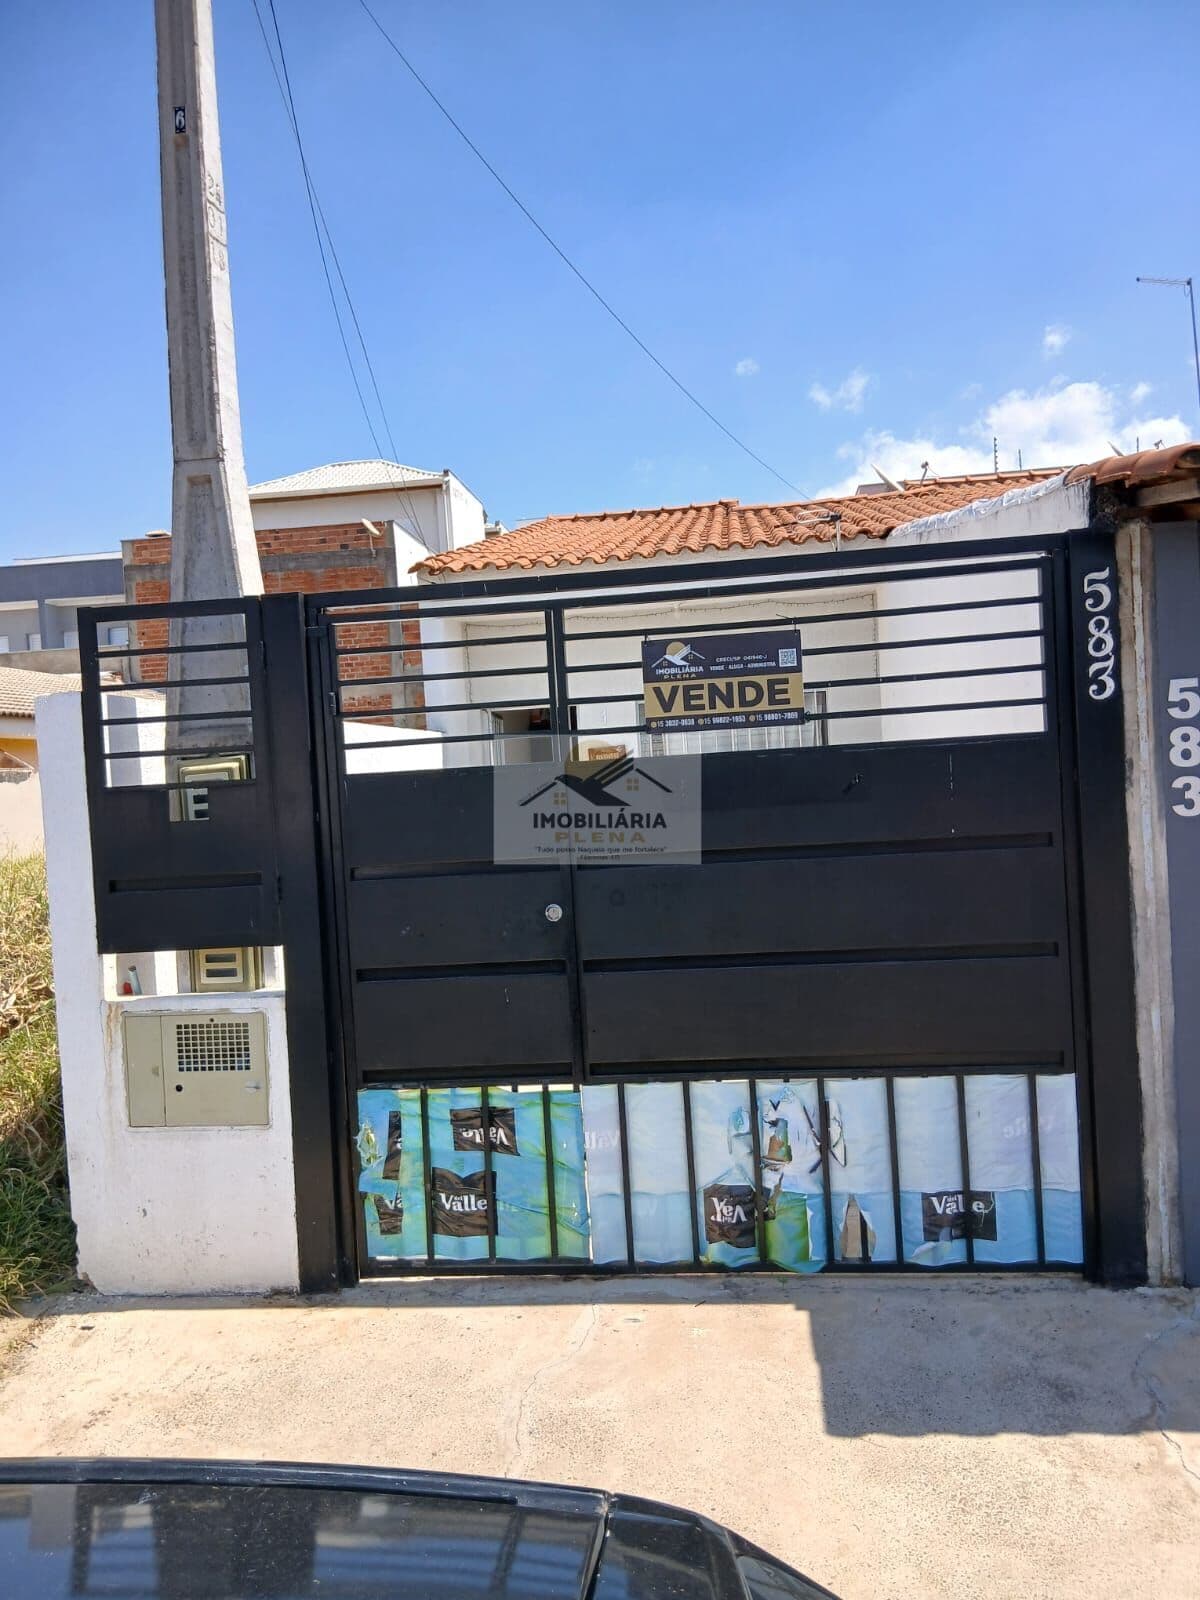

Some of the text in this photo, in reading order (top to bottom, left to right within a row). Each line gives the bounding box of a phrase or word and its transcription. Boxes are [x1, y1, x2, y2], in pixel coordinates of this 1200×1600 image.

[175, 110, 185, 129] 6
[1083, 566, 1116, 701] 583
[655, 665, 704, 675] IMOBILIÁRIA
[652, 677, 791, 714] VENDE
[1167, 677, 1200, 817] 583
[439, 1193, 488, 1212] Valle
[929, 1195, 987, 1215] Vale
